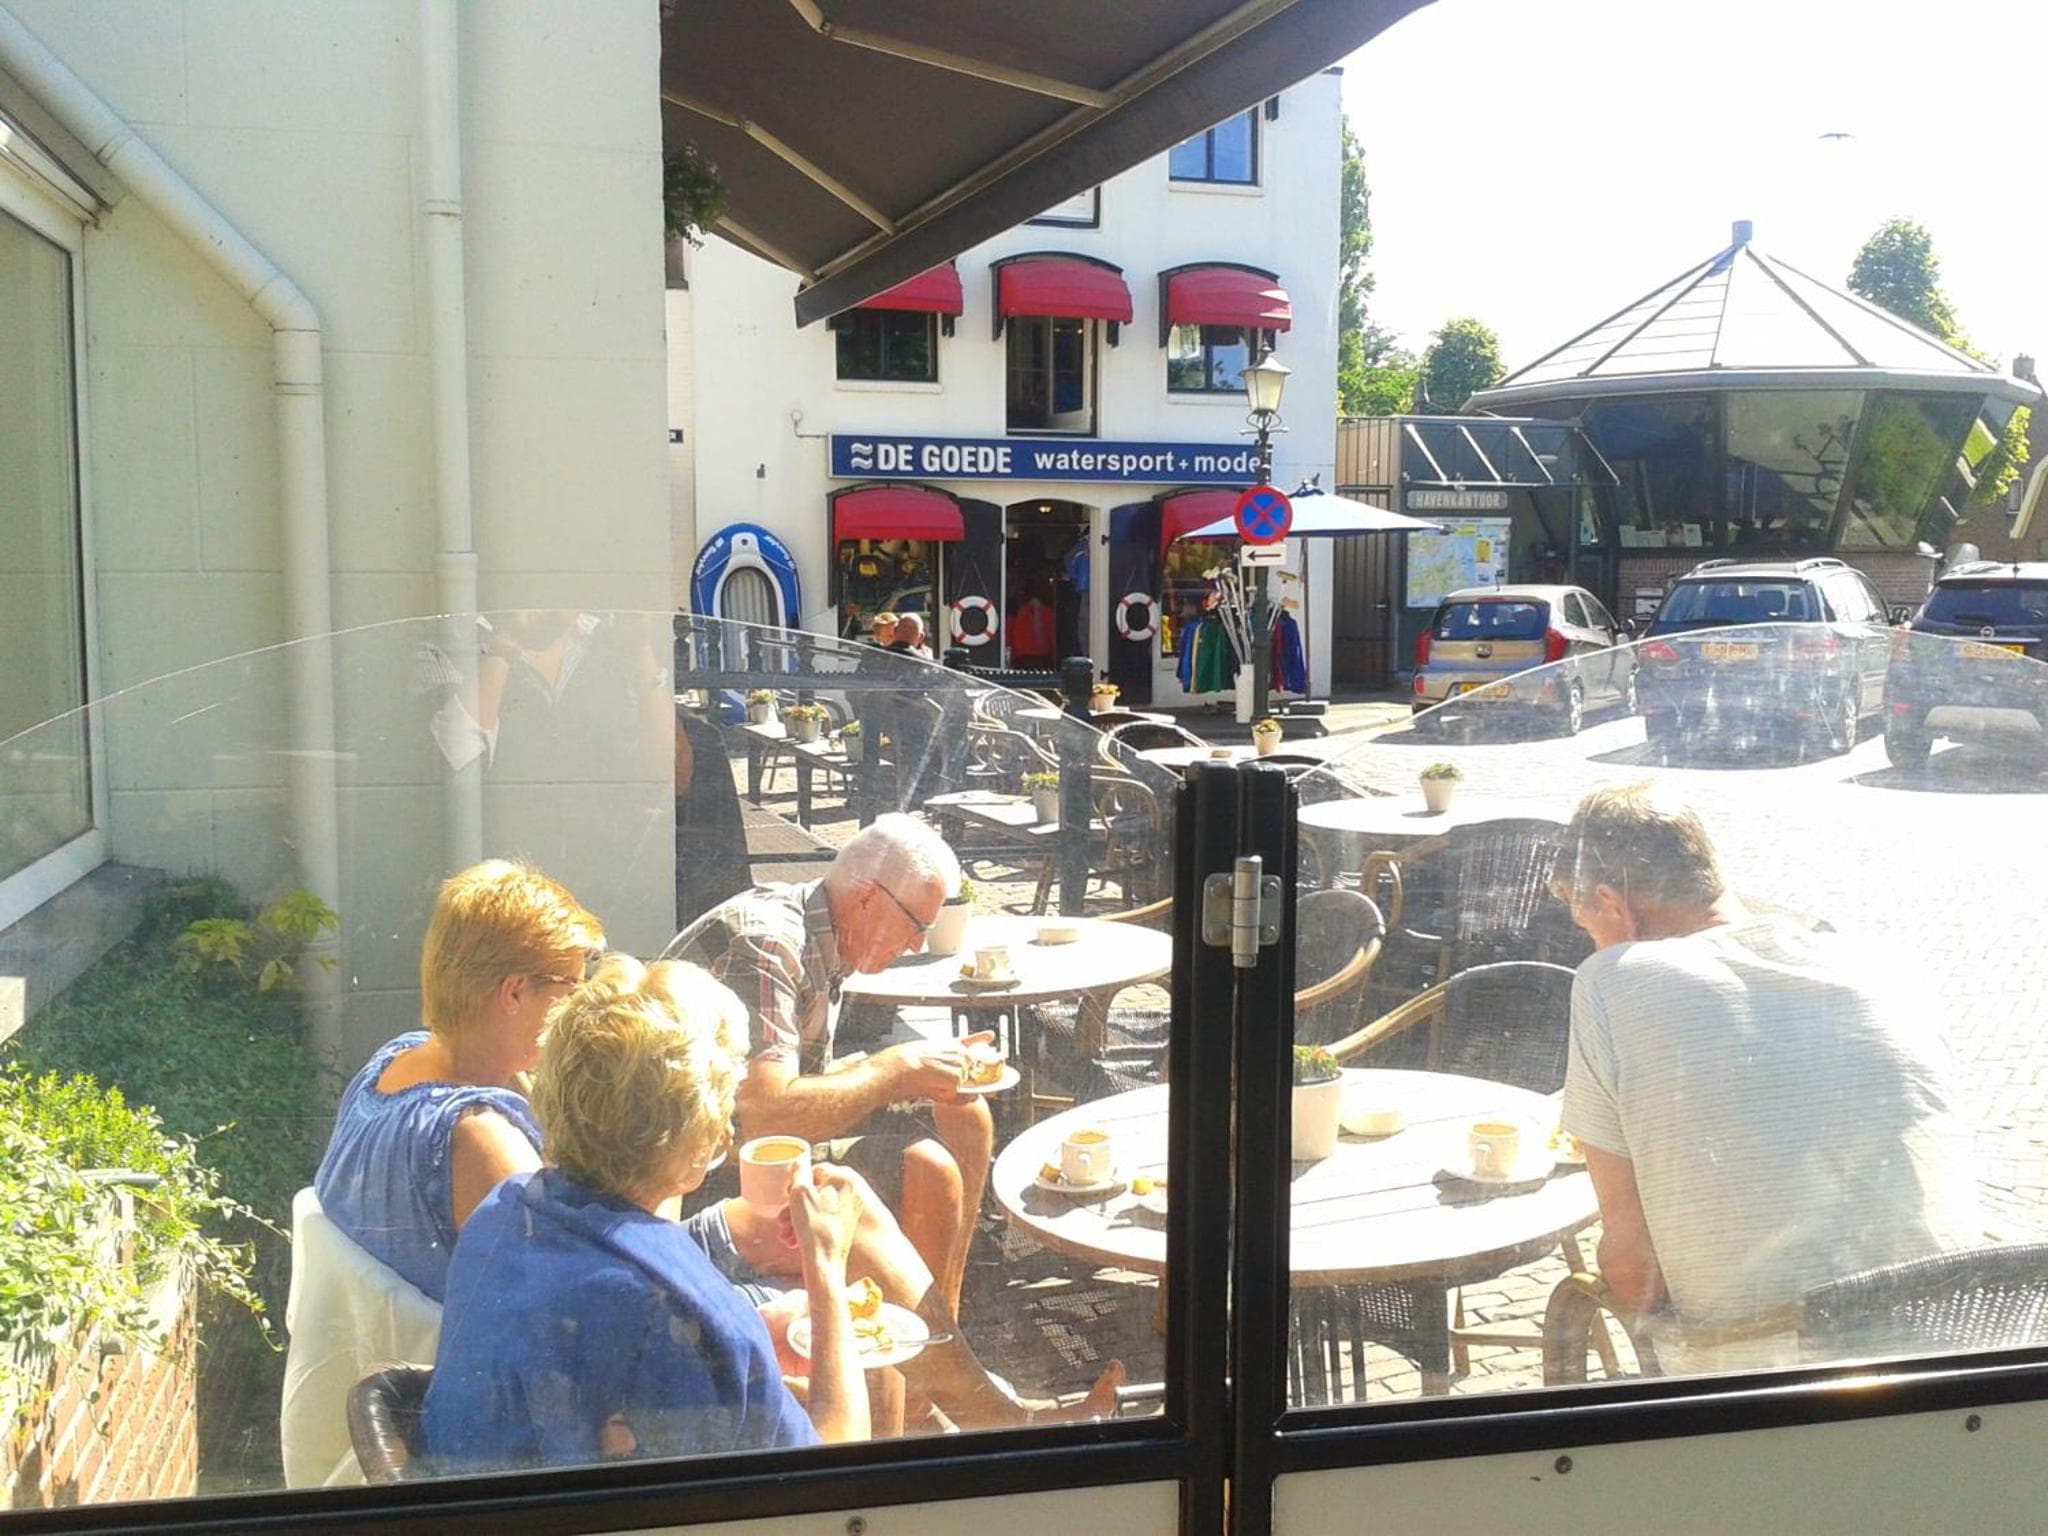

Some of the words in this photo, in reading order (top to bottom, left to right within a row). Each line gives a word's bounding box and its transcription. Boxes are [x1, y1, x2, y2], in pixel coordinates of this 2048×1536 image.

[877, 444, 913, 471] DE
[922, 445, 1012, 473] GOEDE
[1034, 450, 1174, 476] watersport
[1194, 452, 1261, 472] mode
